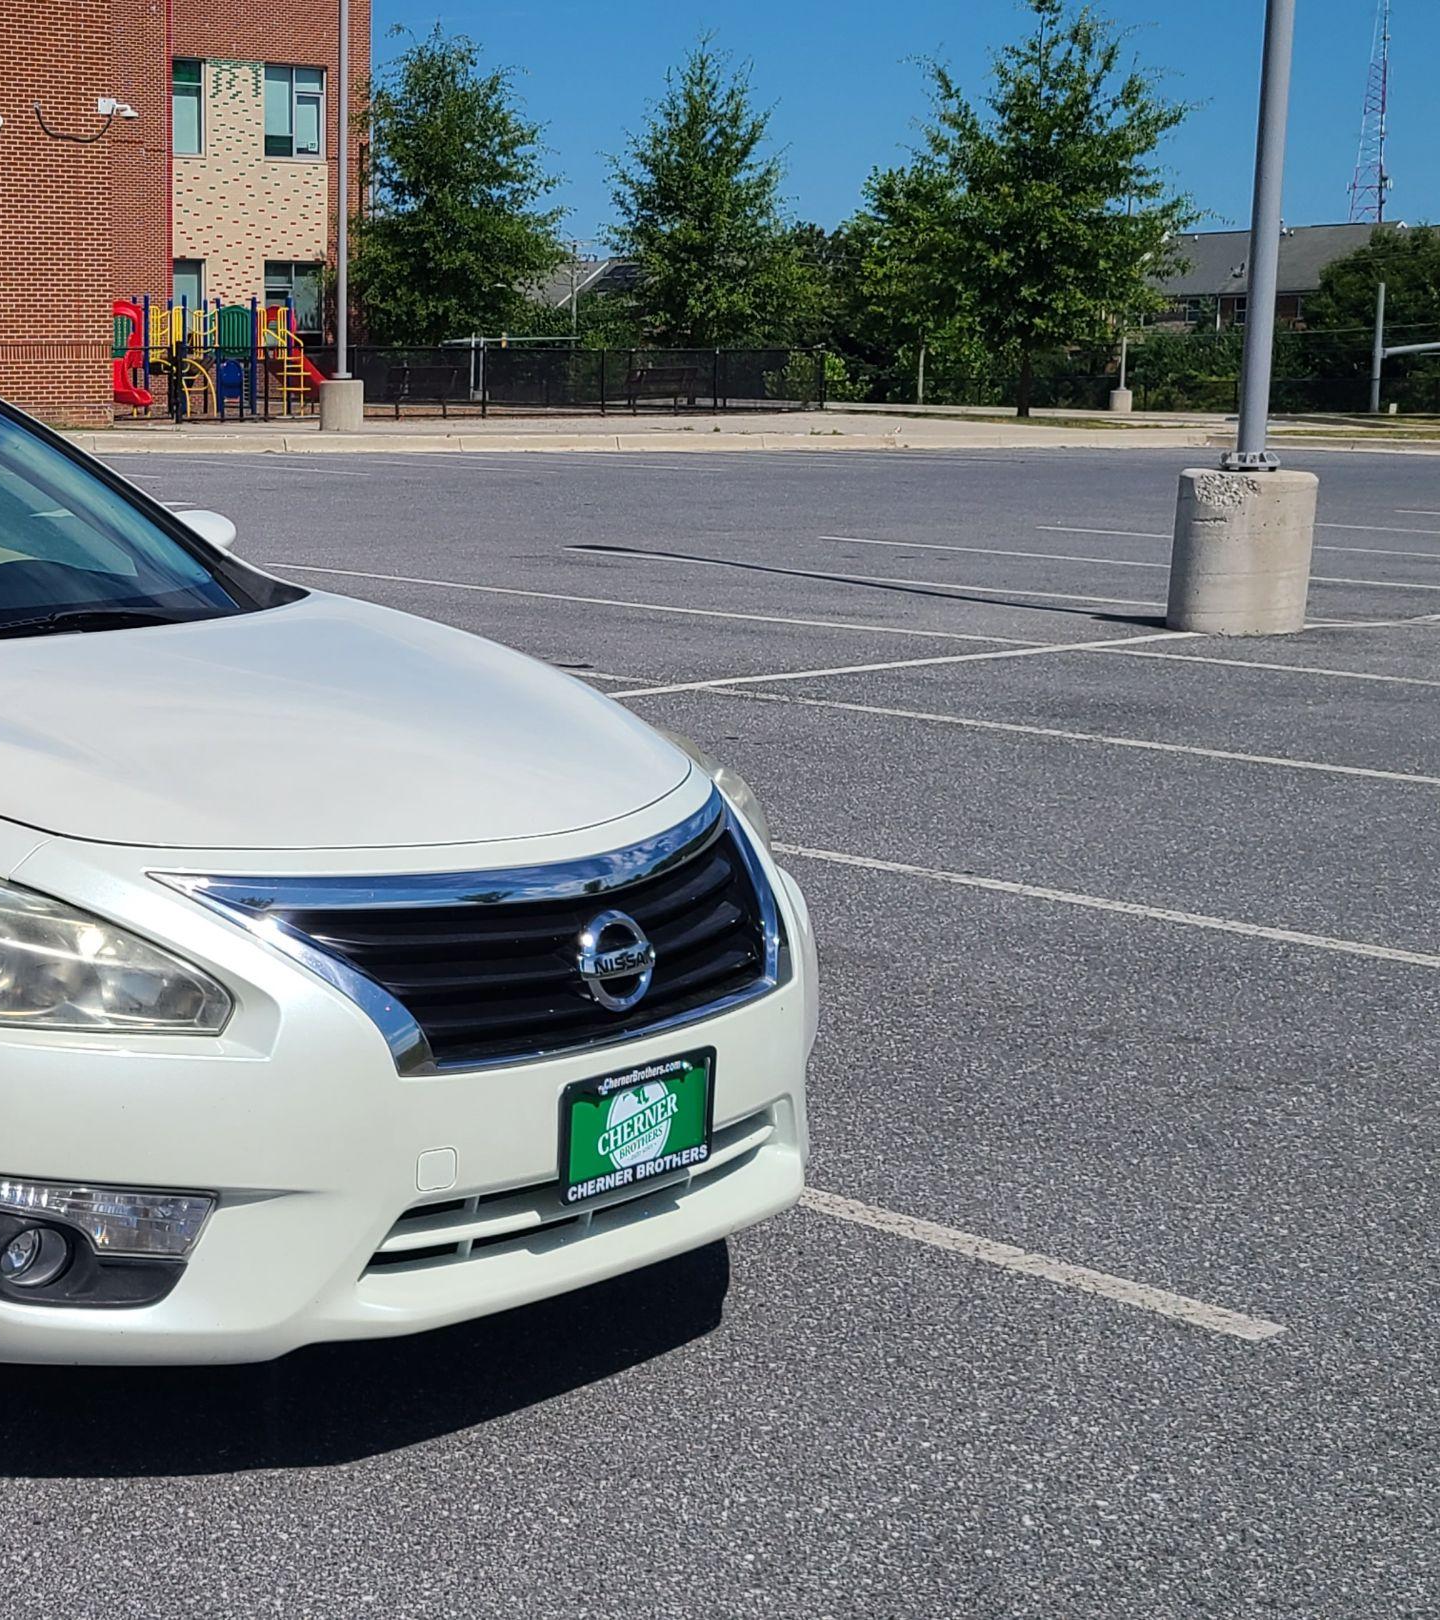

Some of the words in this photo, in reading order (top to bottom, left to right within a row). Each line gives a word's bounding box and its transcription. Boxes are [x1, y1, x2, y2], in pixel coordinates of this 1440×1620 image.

[594, 947, 654, 975] NISSAN
[603, 1060, 681, 1090] ChernerBrothers.com
[597, 1093, 679, 1156] CHERNER
[619, 1125, 663, 1159] BROTHERS
[567, 1167, 633, 1201] CHERNER
[636, 1144, 708, 1180] BROTHERS
